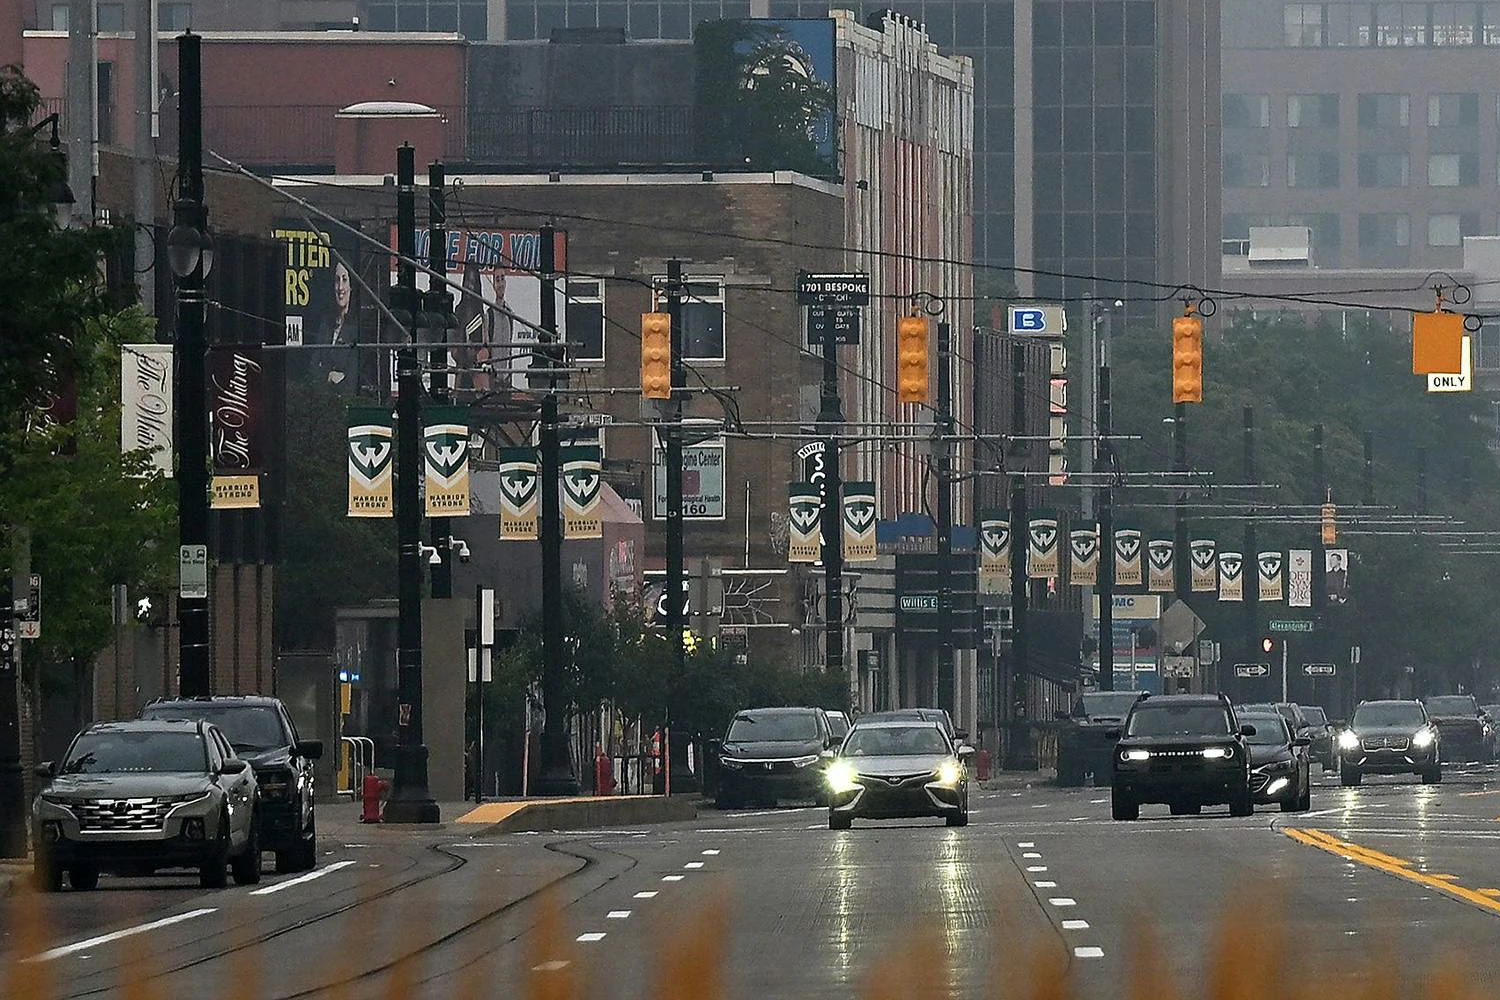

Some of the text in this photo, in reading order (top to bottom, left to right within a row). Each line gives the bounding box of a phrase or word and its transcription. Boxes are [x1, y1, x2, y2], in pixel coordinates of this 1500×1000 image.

[463, 231, 504, 272] FOR
[801, 283, 867, 293] 1701 BESPOKE
[137, 356, 169, 394] The
[1433, 376, 1466, 388] ONLY
[211, 352, 262, 469] The Whitney
[432, 500, 463, 508] STRONG
[902, 598, 928, 608] Willis
